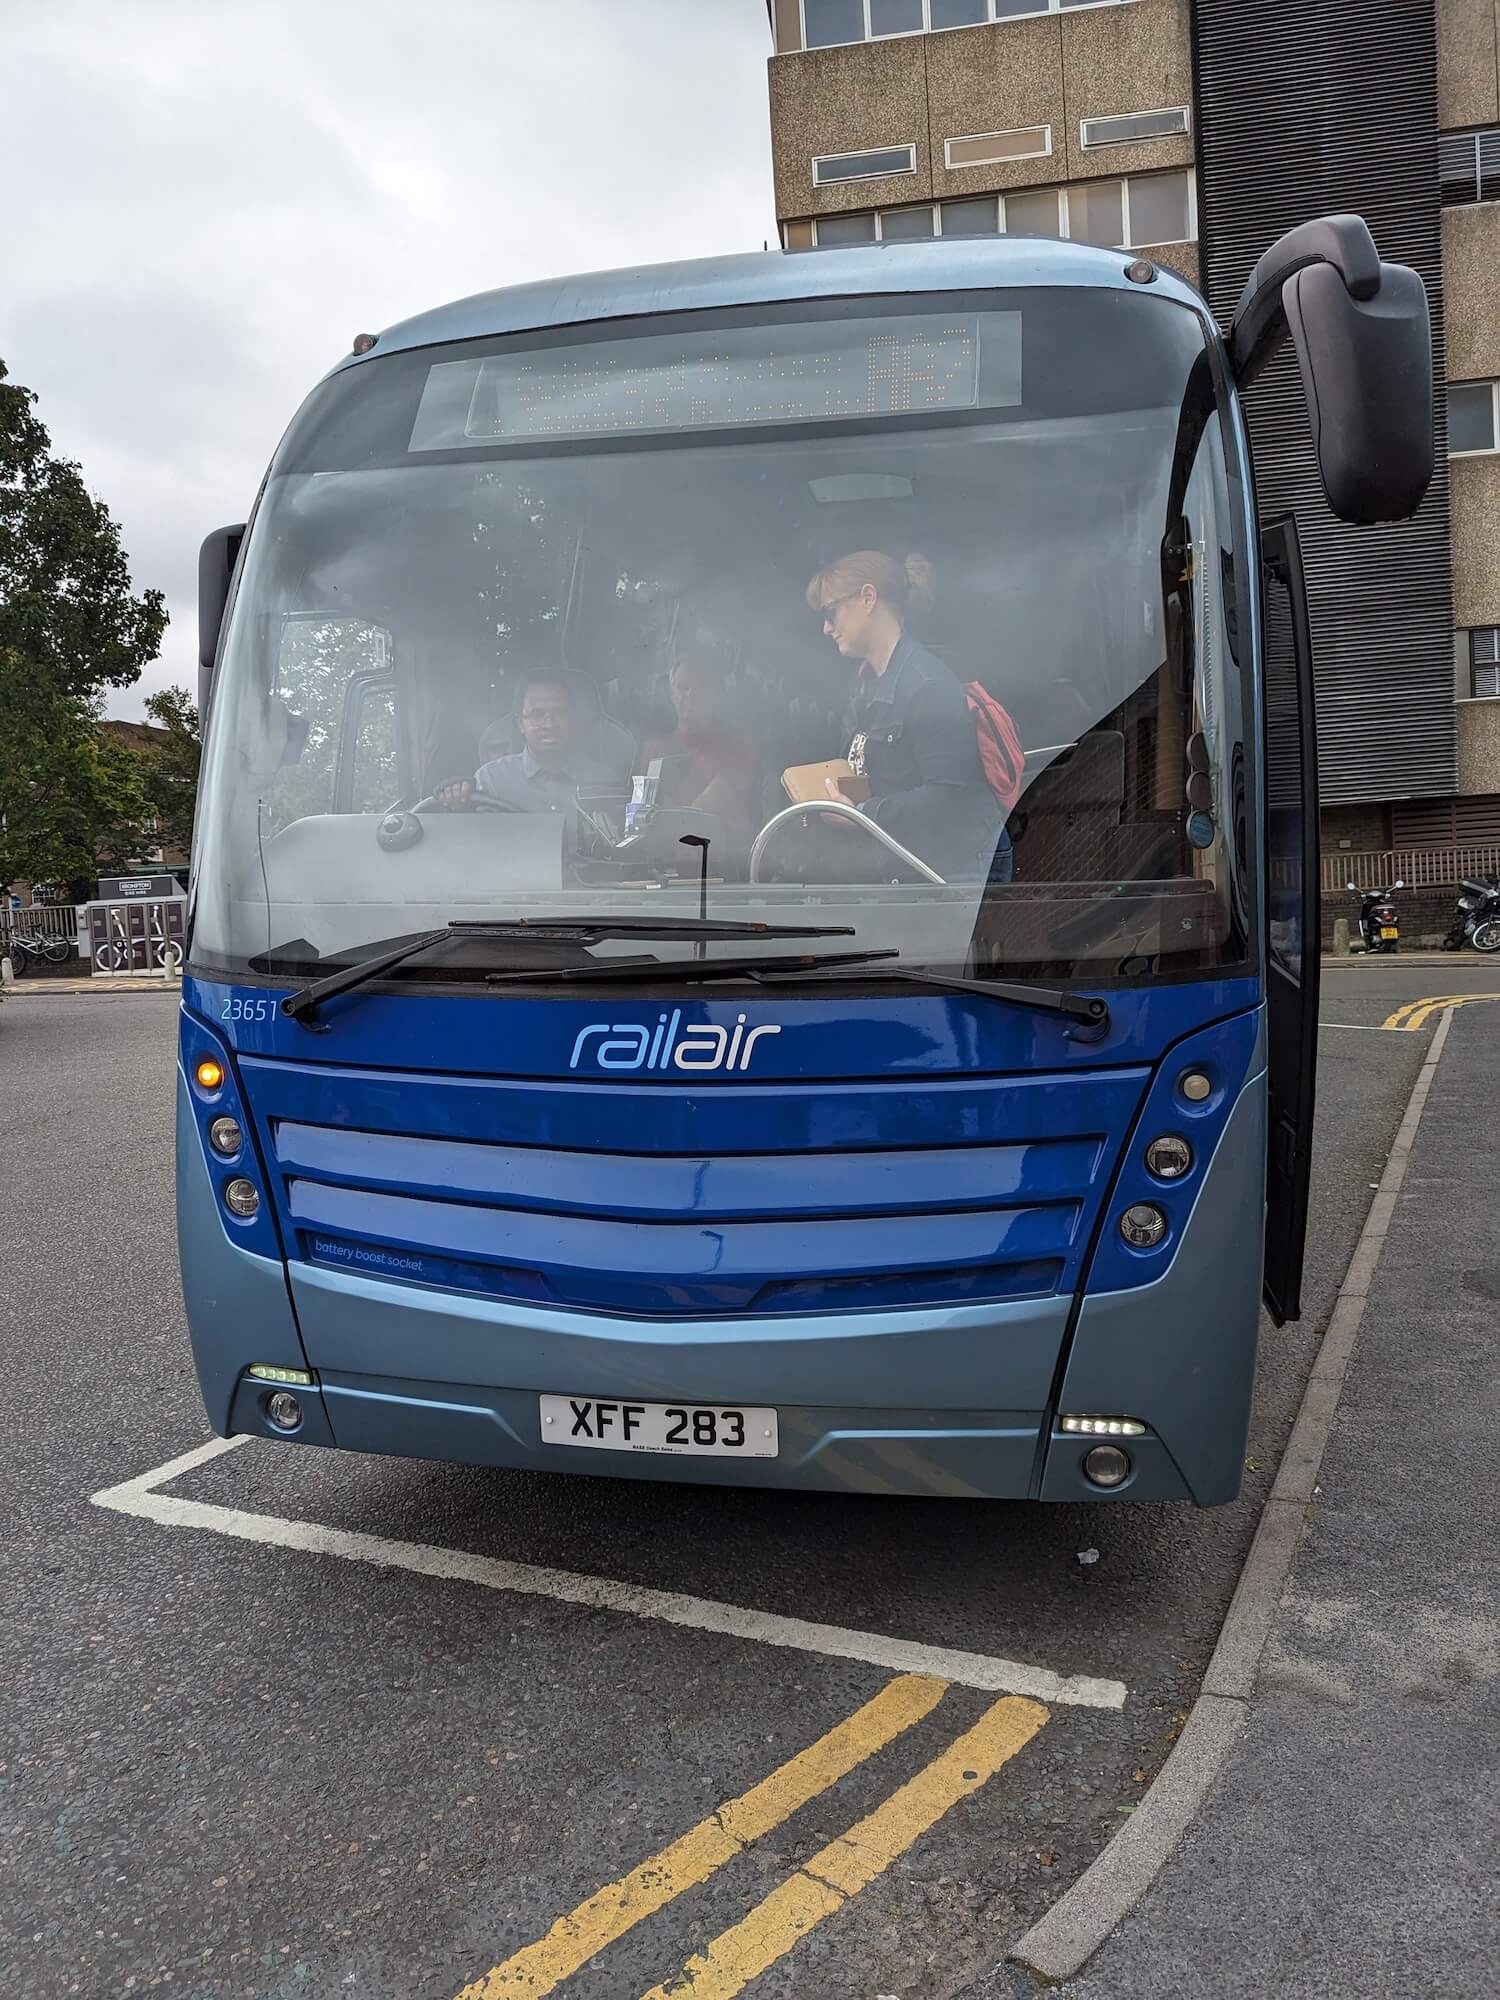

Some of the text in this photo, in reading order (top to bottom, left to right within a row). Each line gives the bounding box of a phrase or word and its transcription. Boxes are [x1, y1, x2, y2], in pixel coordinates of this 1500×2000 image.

[221, 998, 277, 1022] 23651
[569, 1008, 782, 1071] railair
[315, 1240, 423, 1272] battery boost socket
[569, 1400, 746, 1447] XFF 283
